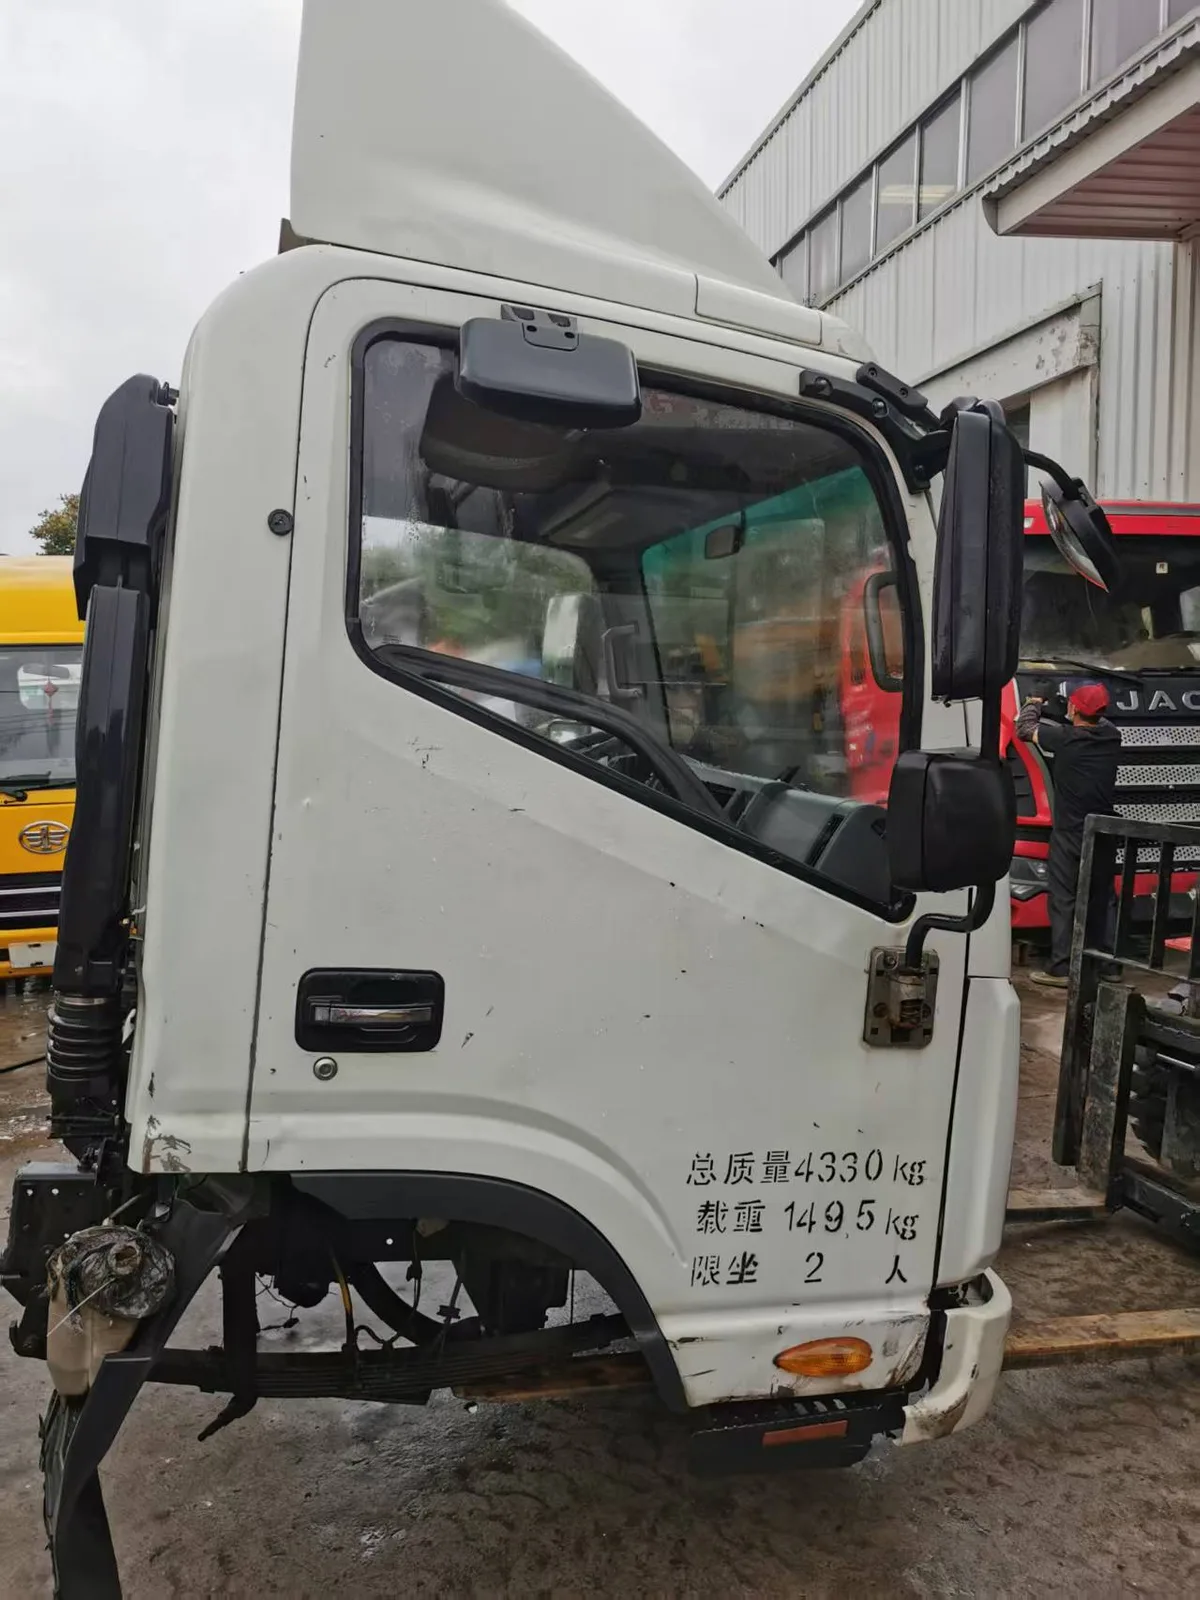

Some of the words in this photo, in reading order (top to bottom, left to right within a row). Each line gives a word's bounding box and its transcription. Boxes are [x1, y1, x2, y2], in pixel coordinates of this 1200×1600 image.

[1117, 690, 1200, 711] JAC
[892, 1154, 927, 1187] kg
[696, 1199, 766, 1235] 载重
[885, 1207, 920, 1241] kg
[690, 1250, 759, 1287] 限坐
[803, 1251, 824, 1284] 2
[884, 1254, 908, 1285] 人
